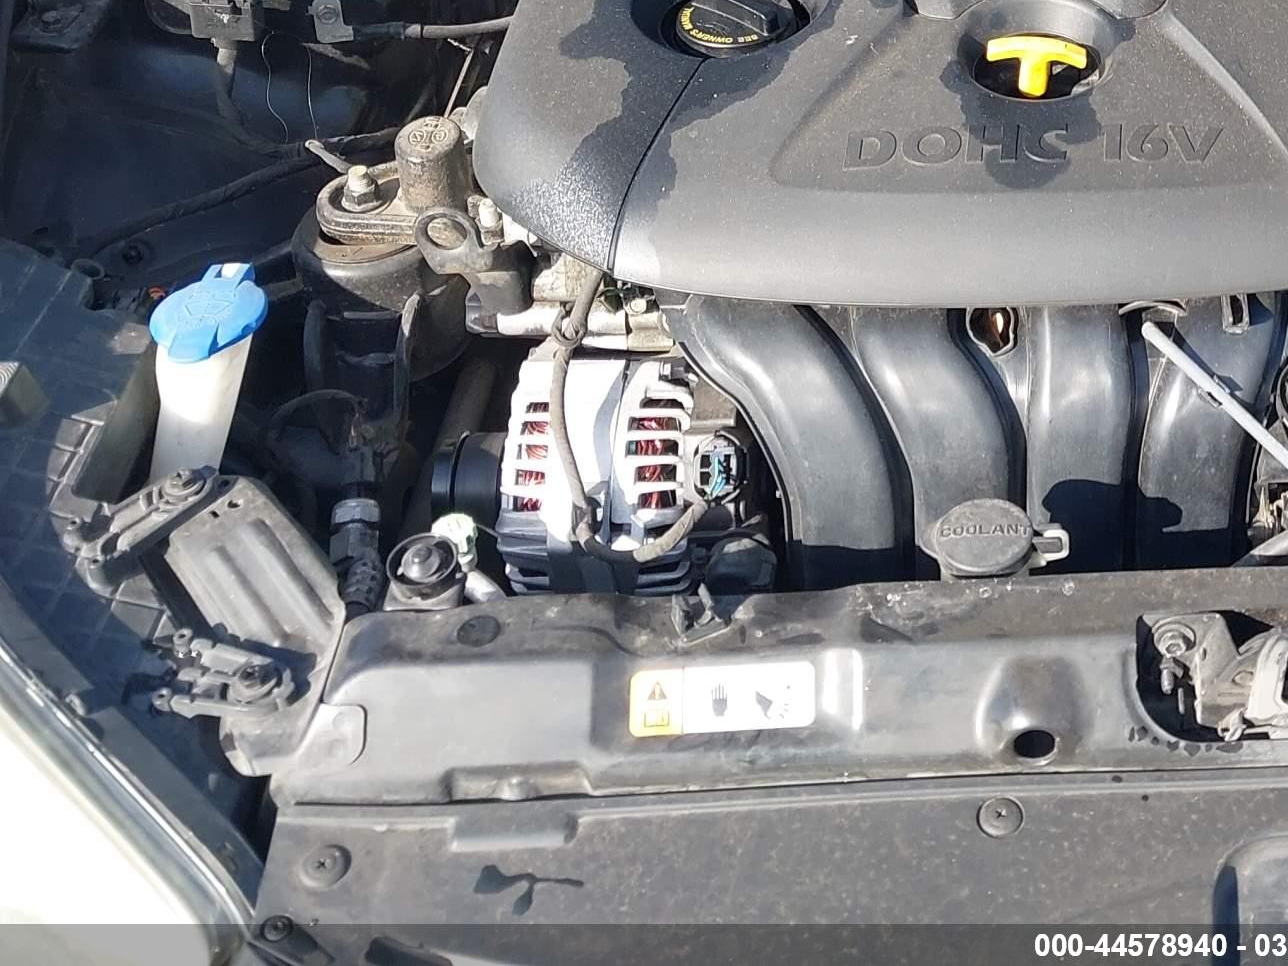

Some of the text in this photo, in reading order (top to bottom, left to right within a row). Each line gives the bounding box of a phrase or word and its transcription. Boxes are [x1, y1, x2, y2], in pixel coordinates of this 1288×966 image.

[842, 123, 1225, 171] DOHC 16V
[940, 522, 1032, 539] COOLANT
